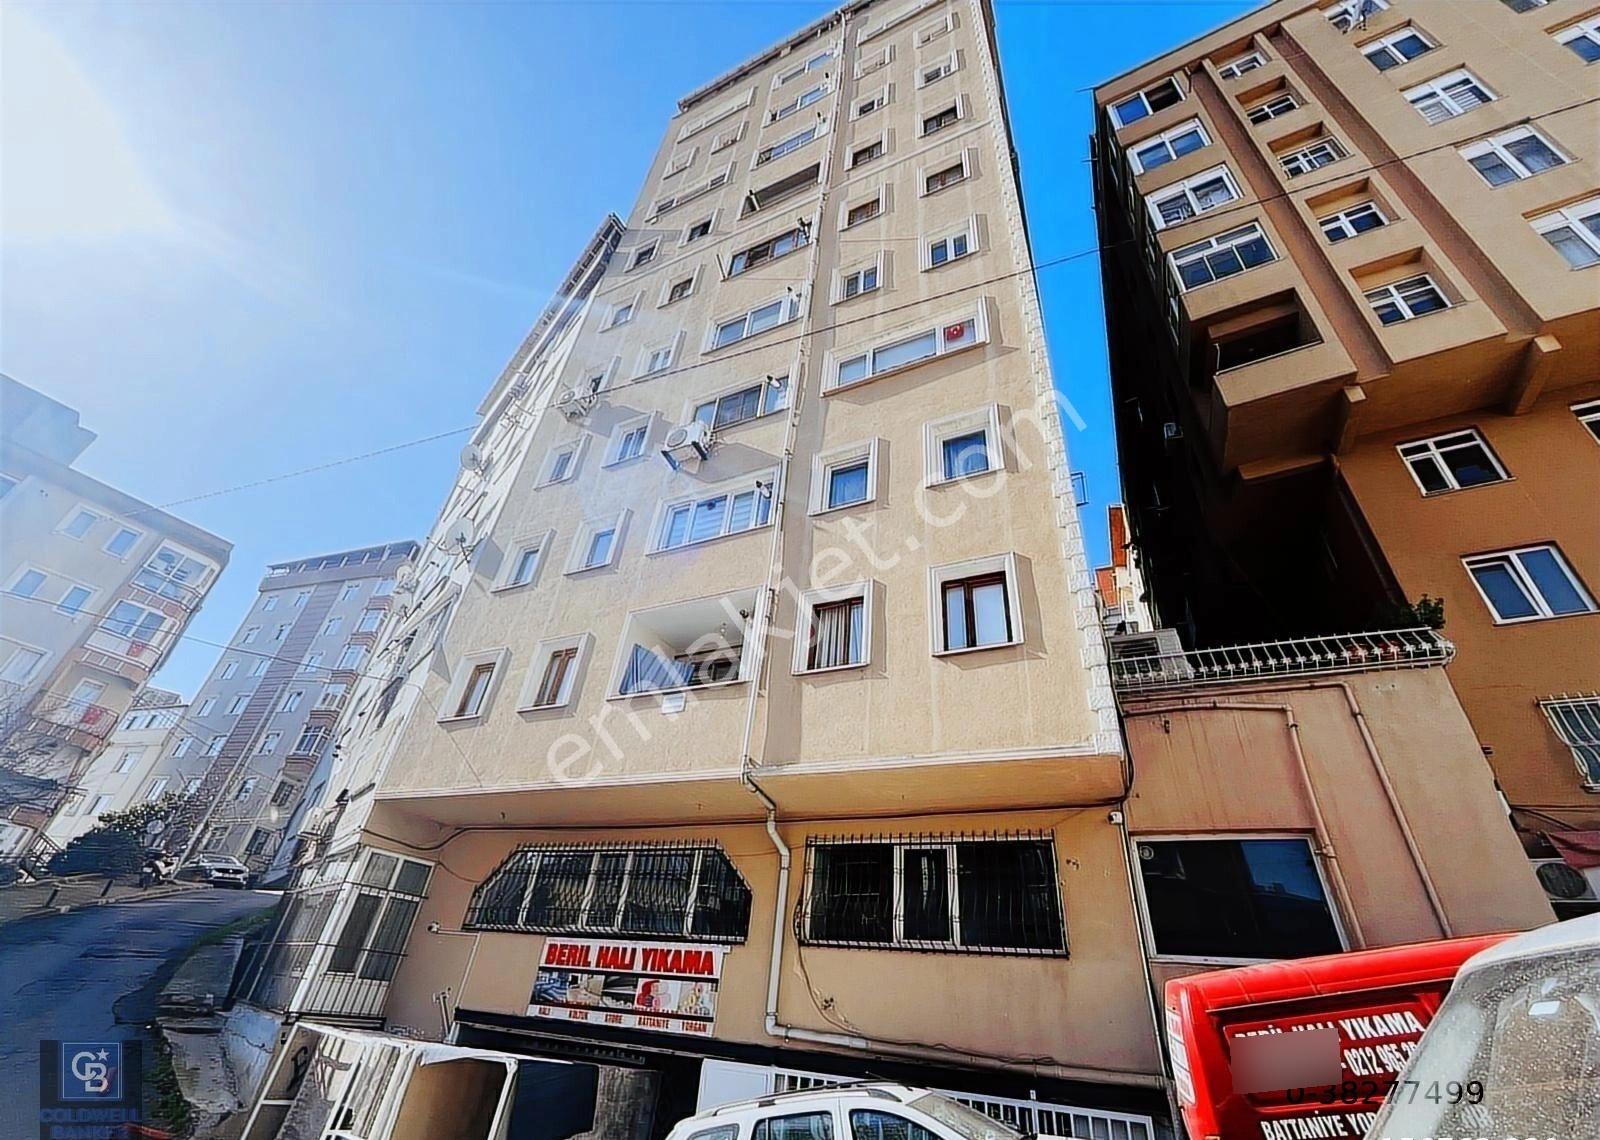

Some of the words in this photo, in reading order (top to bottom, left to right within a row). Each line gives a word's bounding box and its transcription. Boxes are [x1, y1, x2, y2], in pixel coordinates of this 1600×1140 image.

[595, 945, 637, 971] HALI
[641, 947, 714, 976] YIKAMA
[1339, 1011, 1425, 1041] YIKAMA
[1344, 1047, 1384, 1076] 0212
